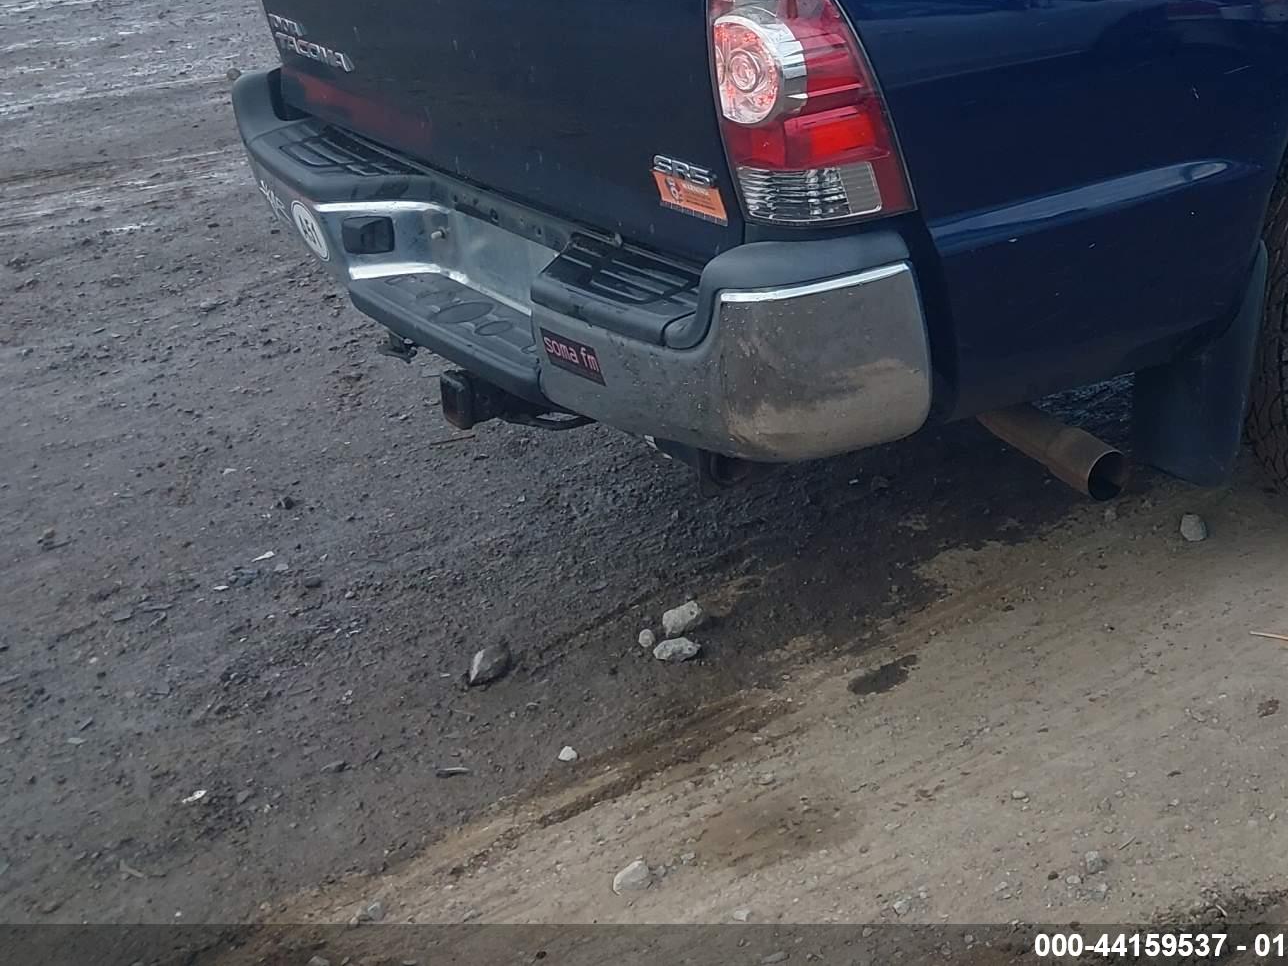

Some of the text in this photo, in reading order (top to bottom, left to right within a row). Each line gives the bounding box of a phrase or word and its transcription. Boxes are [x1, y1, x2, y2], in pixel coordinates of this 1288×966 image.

[274, 31, 354, 72] TACOMA
[653, 154, 711, 187] SR5
[543, 336, 600, 372] soma fm
